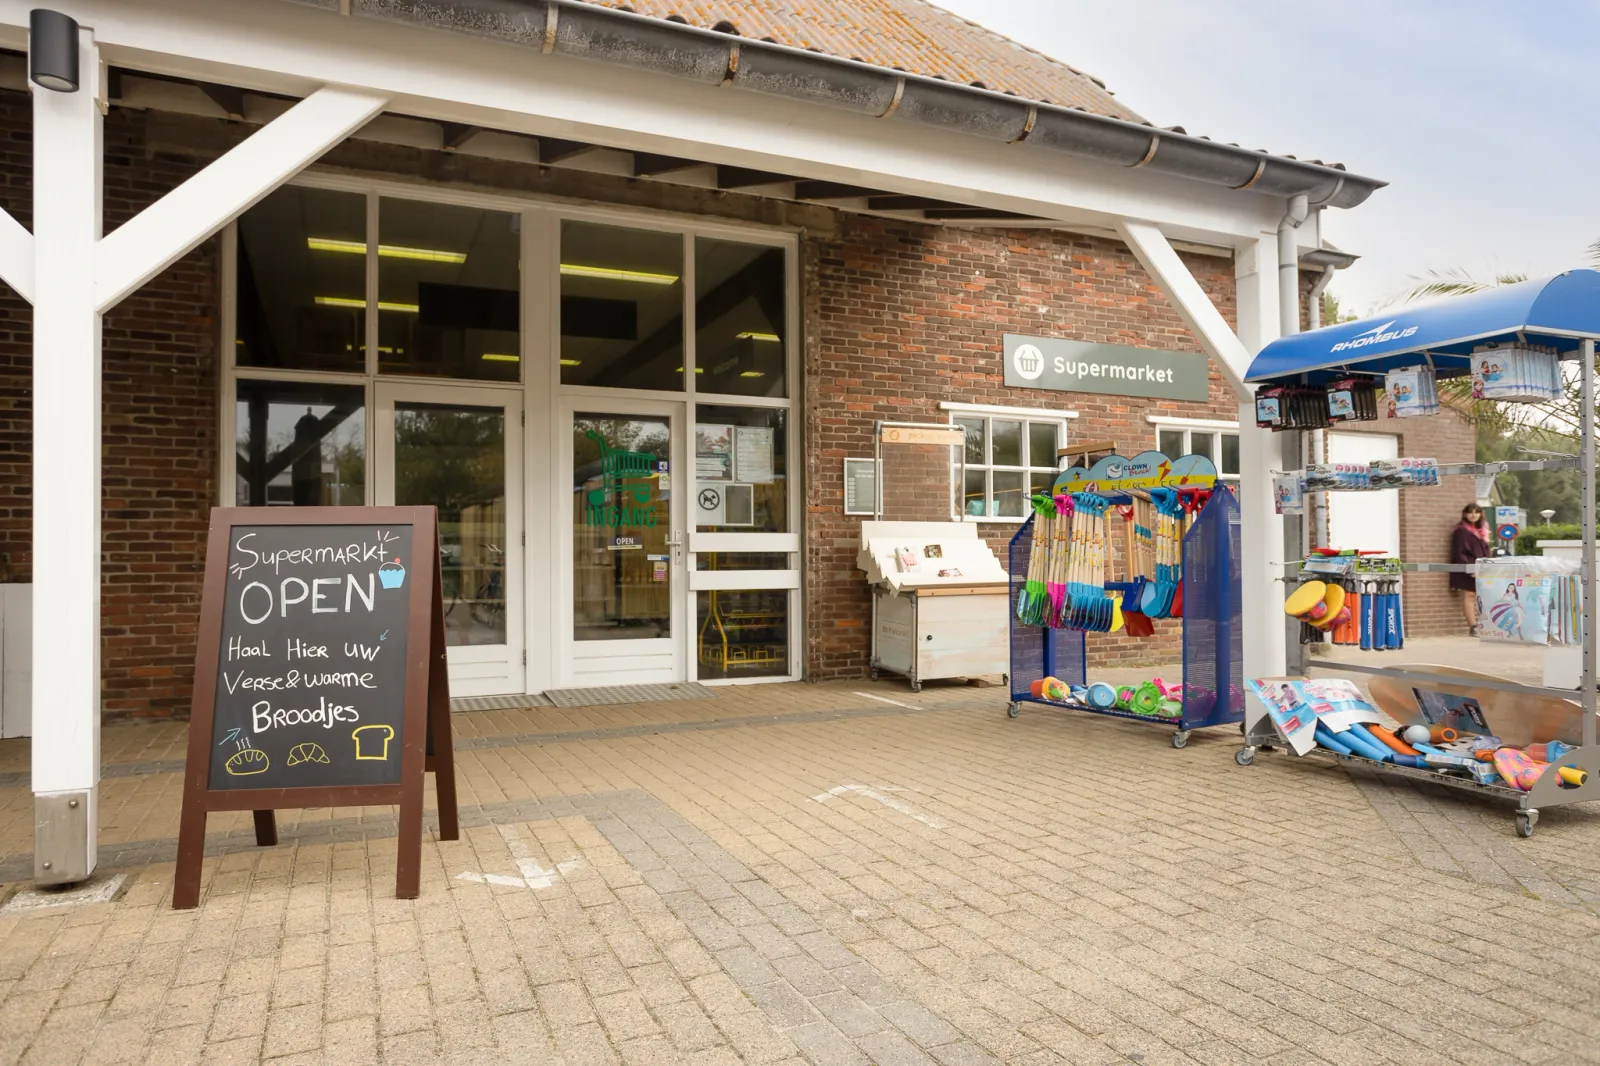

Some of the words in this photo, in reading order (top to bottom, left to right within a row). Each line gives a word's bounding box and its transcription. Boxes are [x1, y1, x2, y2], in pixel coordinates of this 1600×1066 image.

[1330, 326, 1419, 353] RHOMBUS
[1053, 356, 1174, 383] Supermarket
[1123, 463, 1148, 471] CLOWN
[616, 537, 634, 545] OPEN
[240, 573, 375, 624] OPEN
[287, 638, 329, 661] Hier
[252, 696, 360, 733] Broodjes
